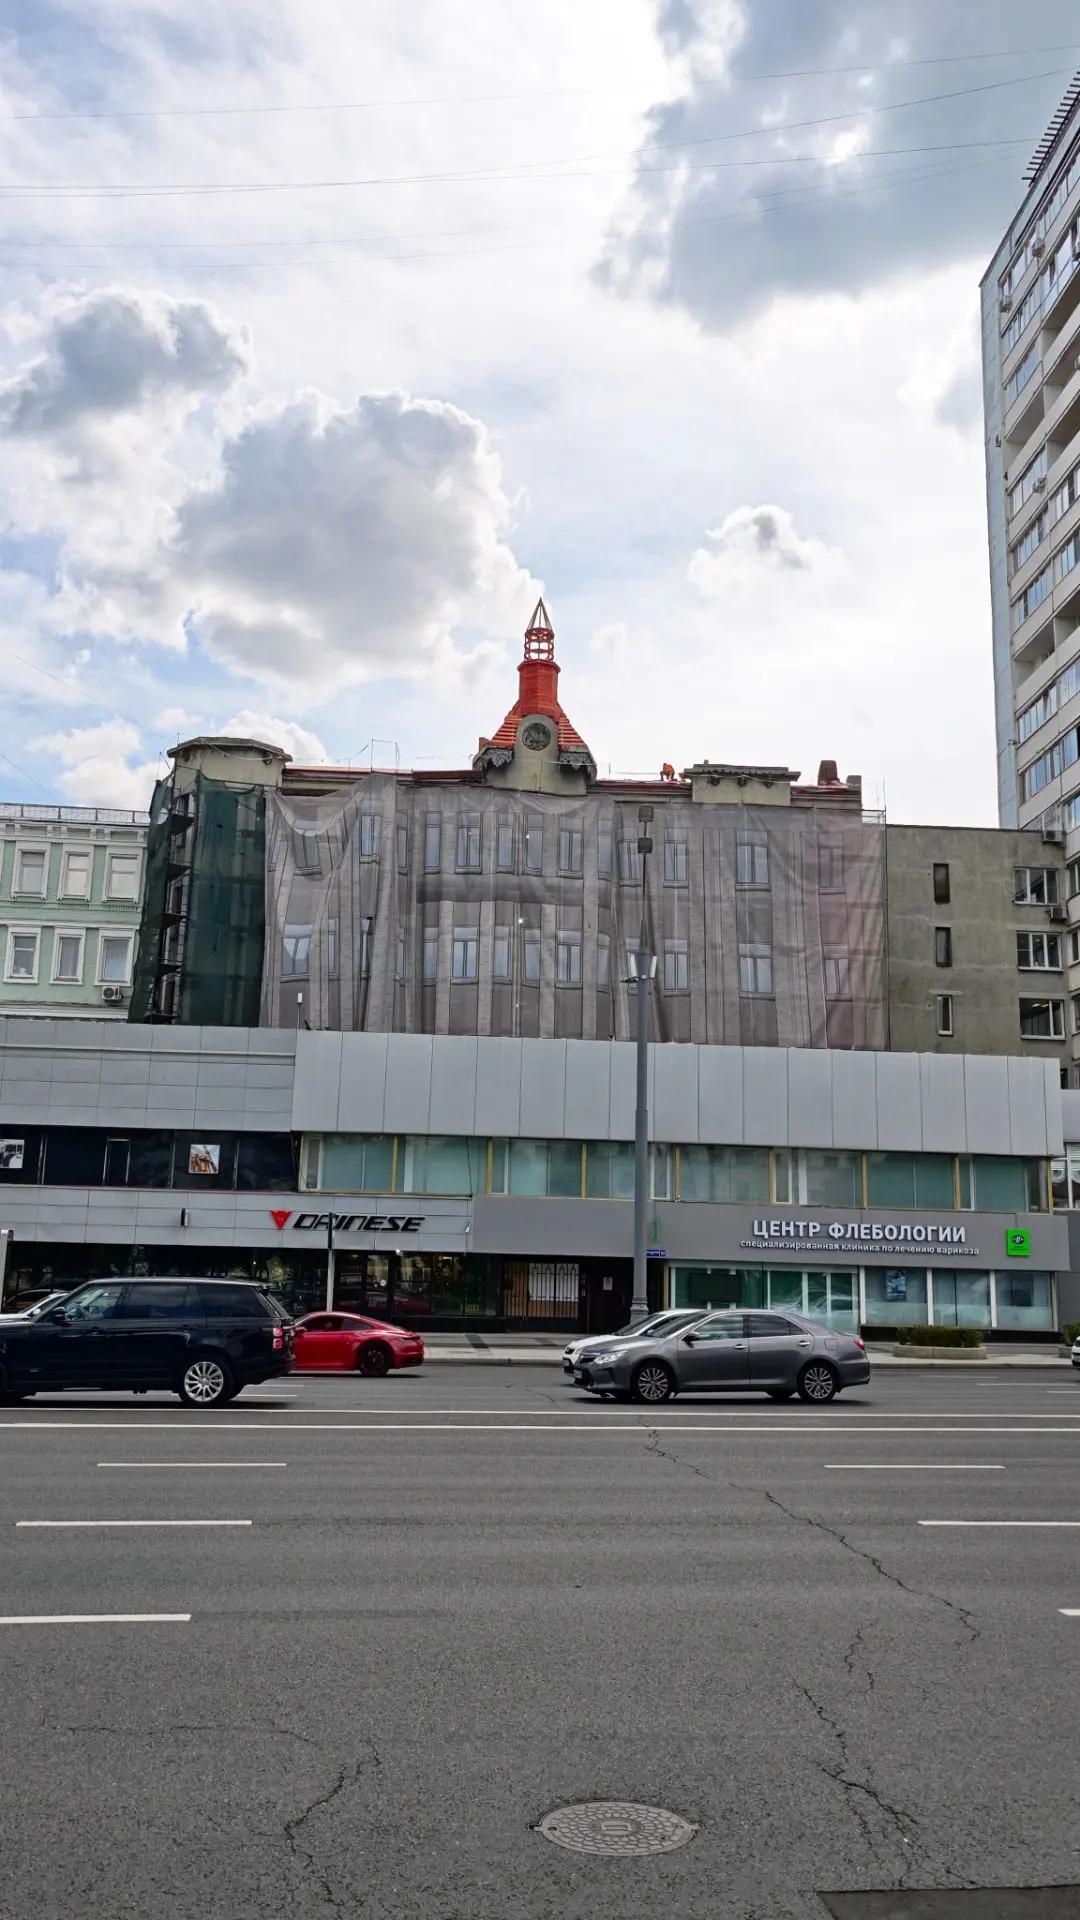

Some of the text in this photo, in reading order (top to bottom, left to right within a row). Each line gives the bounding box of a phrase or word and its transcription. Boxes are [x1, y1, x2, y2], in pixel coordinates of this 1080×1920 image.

[293, 1213, 425, 1232] DAINESE
[753, 1220, 966, 1242] ЦЕНТР ФЛЕБОЛОГИИ
[740, 1239, 980, 1257] специализированная клиника по лечению варикоза
